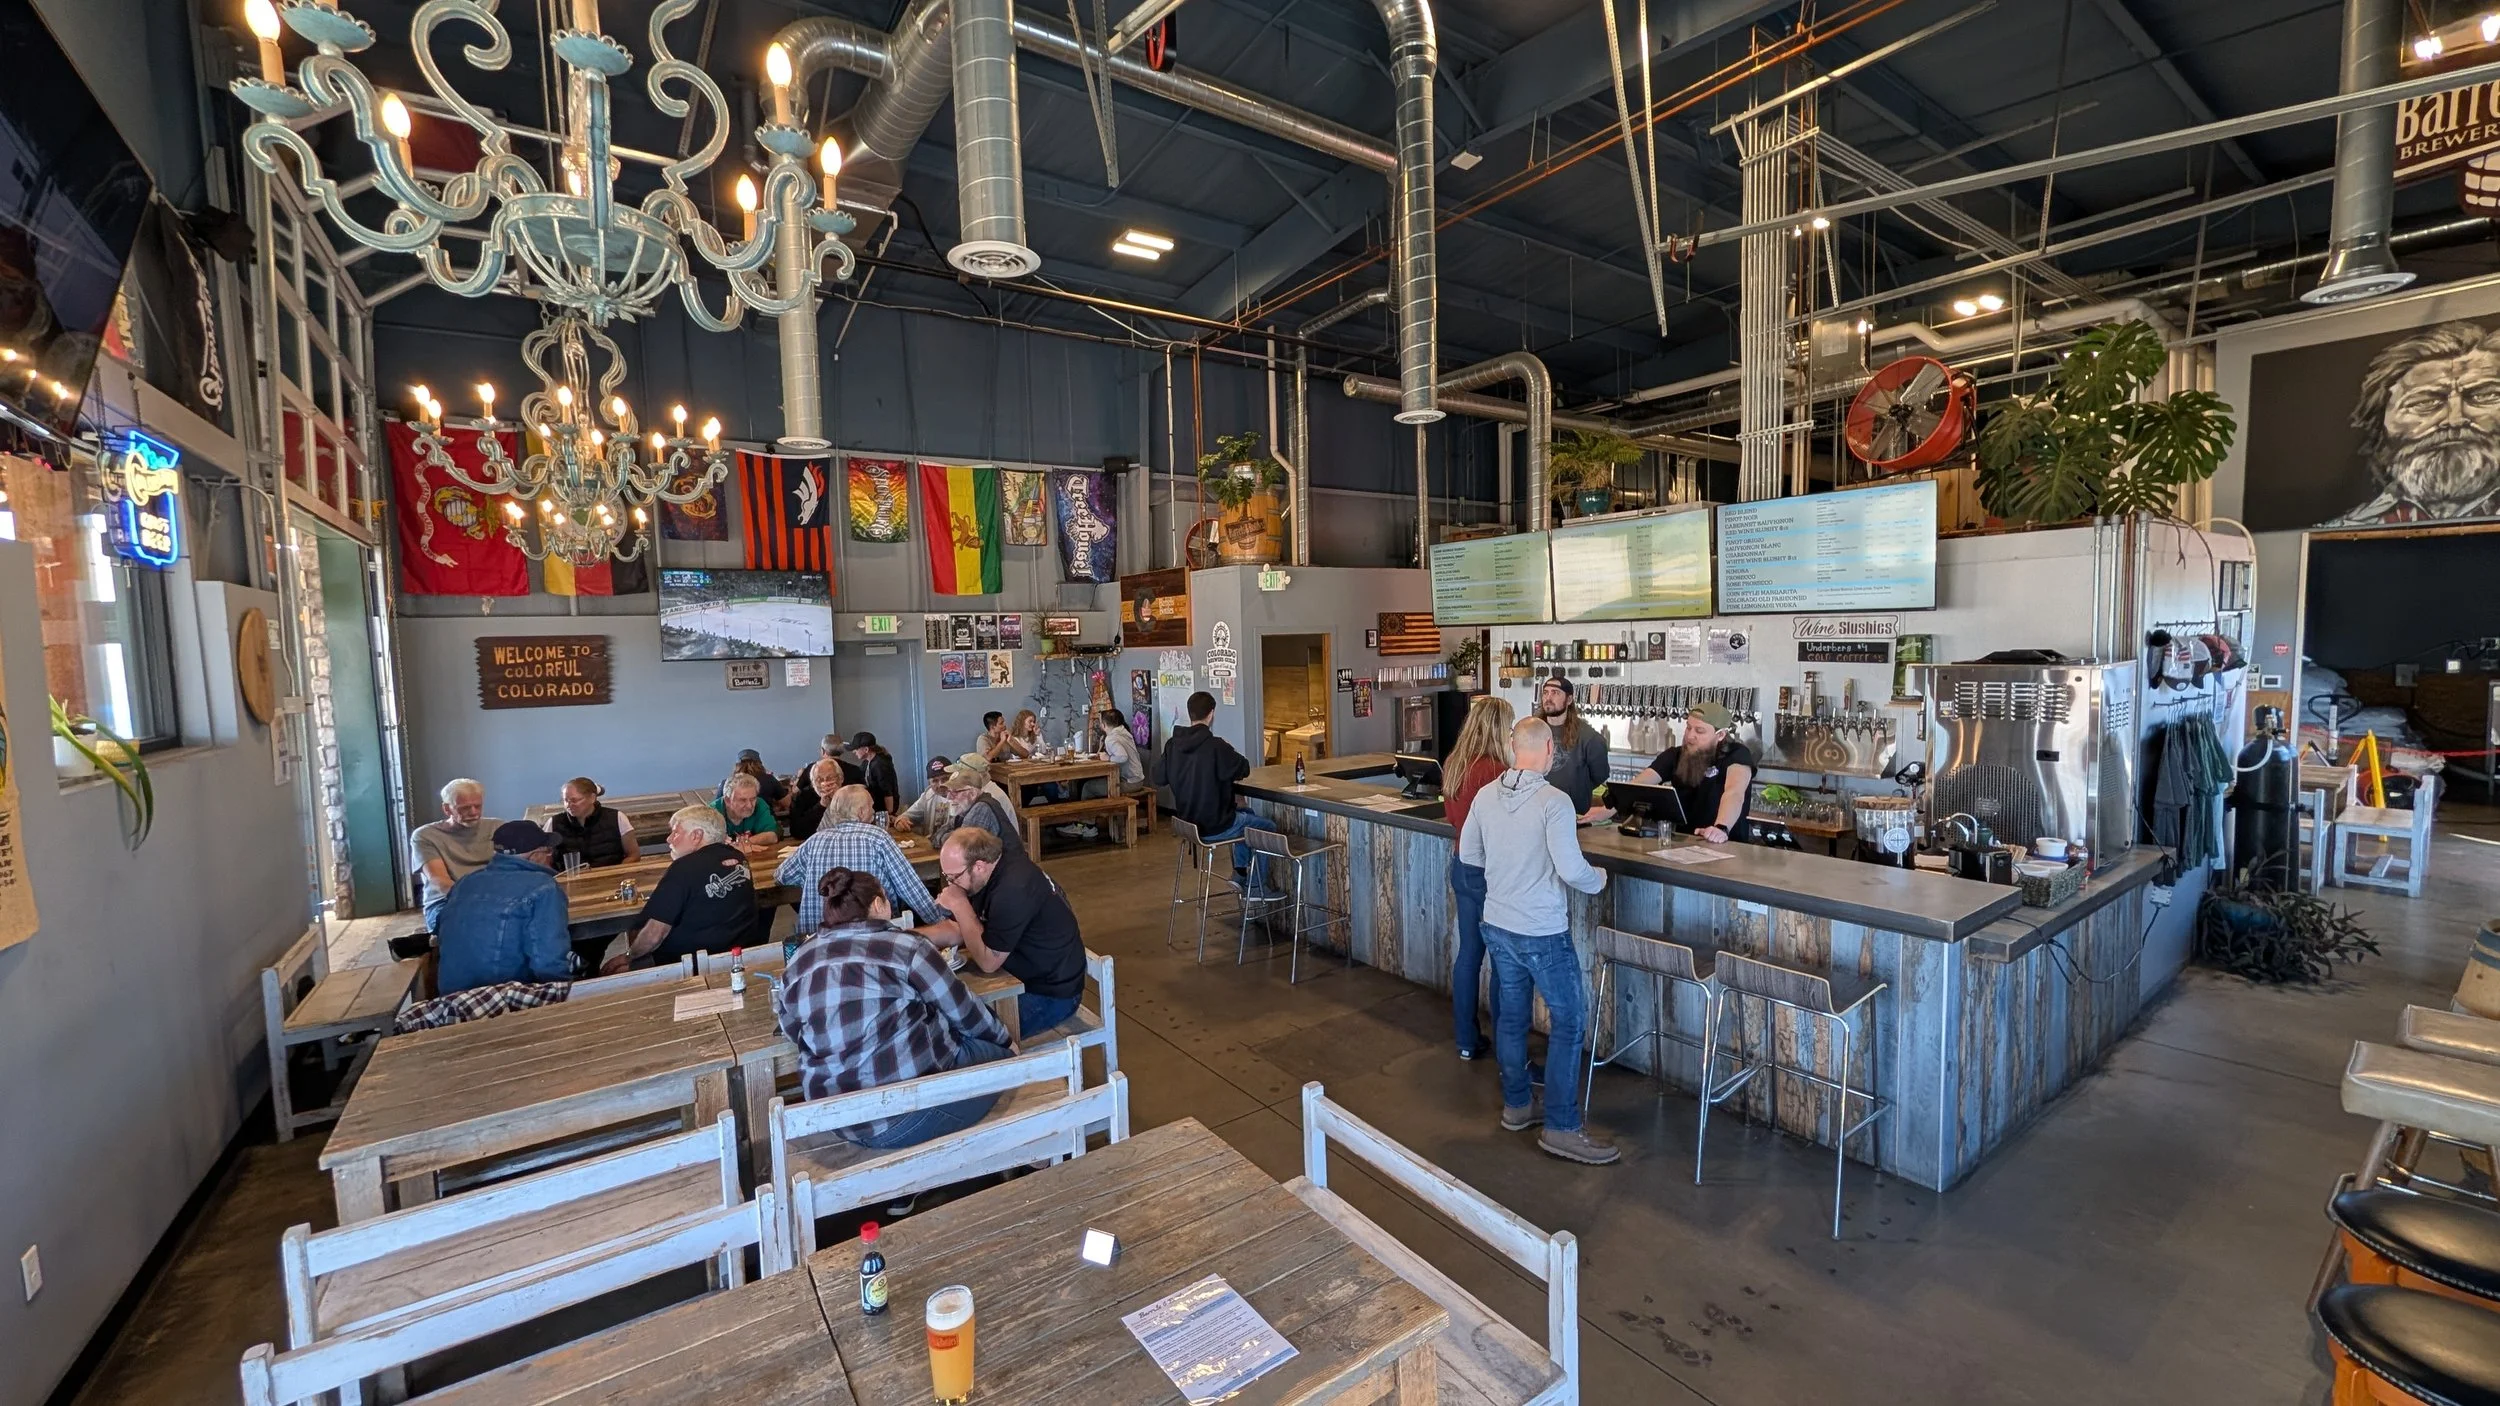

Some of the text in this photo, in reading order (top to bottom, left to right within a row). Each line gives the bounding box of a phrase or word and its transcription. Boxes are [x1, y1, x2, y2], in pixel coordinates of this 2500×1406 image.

[2400, 121, 2500, 160] BREWER
[1265, 572, 1279, 589] EXIT
[871, 616, 892, 632] EXIT
[1798, 618, 1892, 637] Wine Slushies
[494, 645, 590, 665] WELCOME TO
[1207, 649, 1236, 658] COLORADO
[1806, 642, 1851, 652] Underberg
[505, 659, 581, 678] COLORFUL
[498, 682, 594, 698] COLORADO
